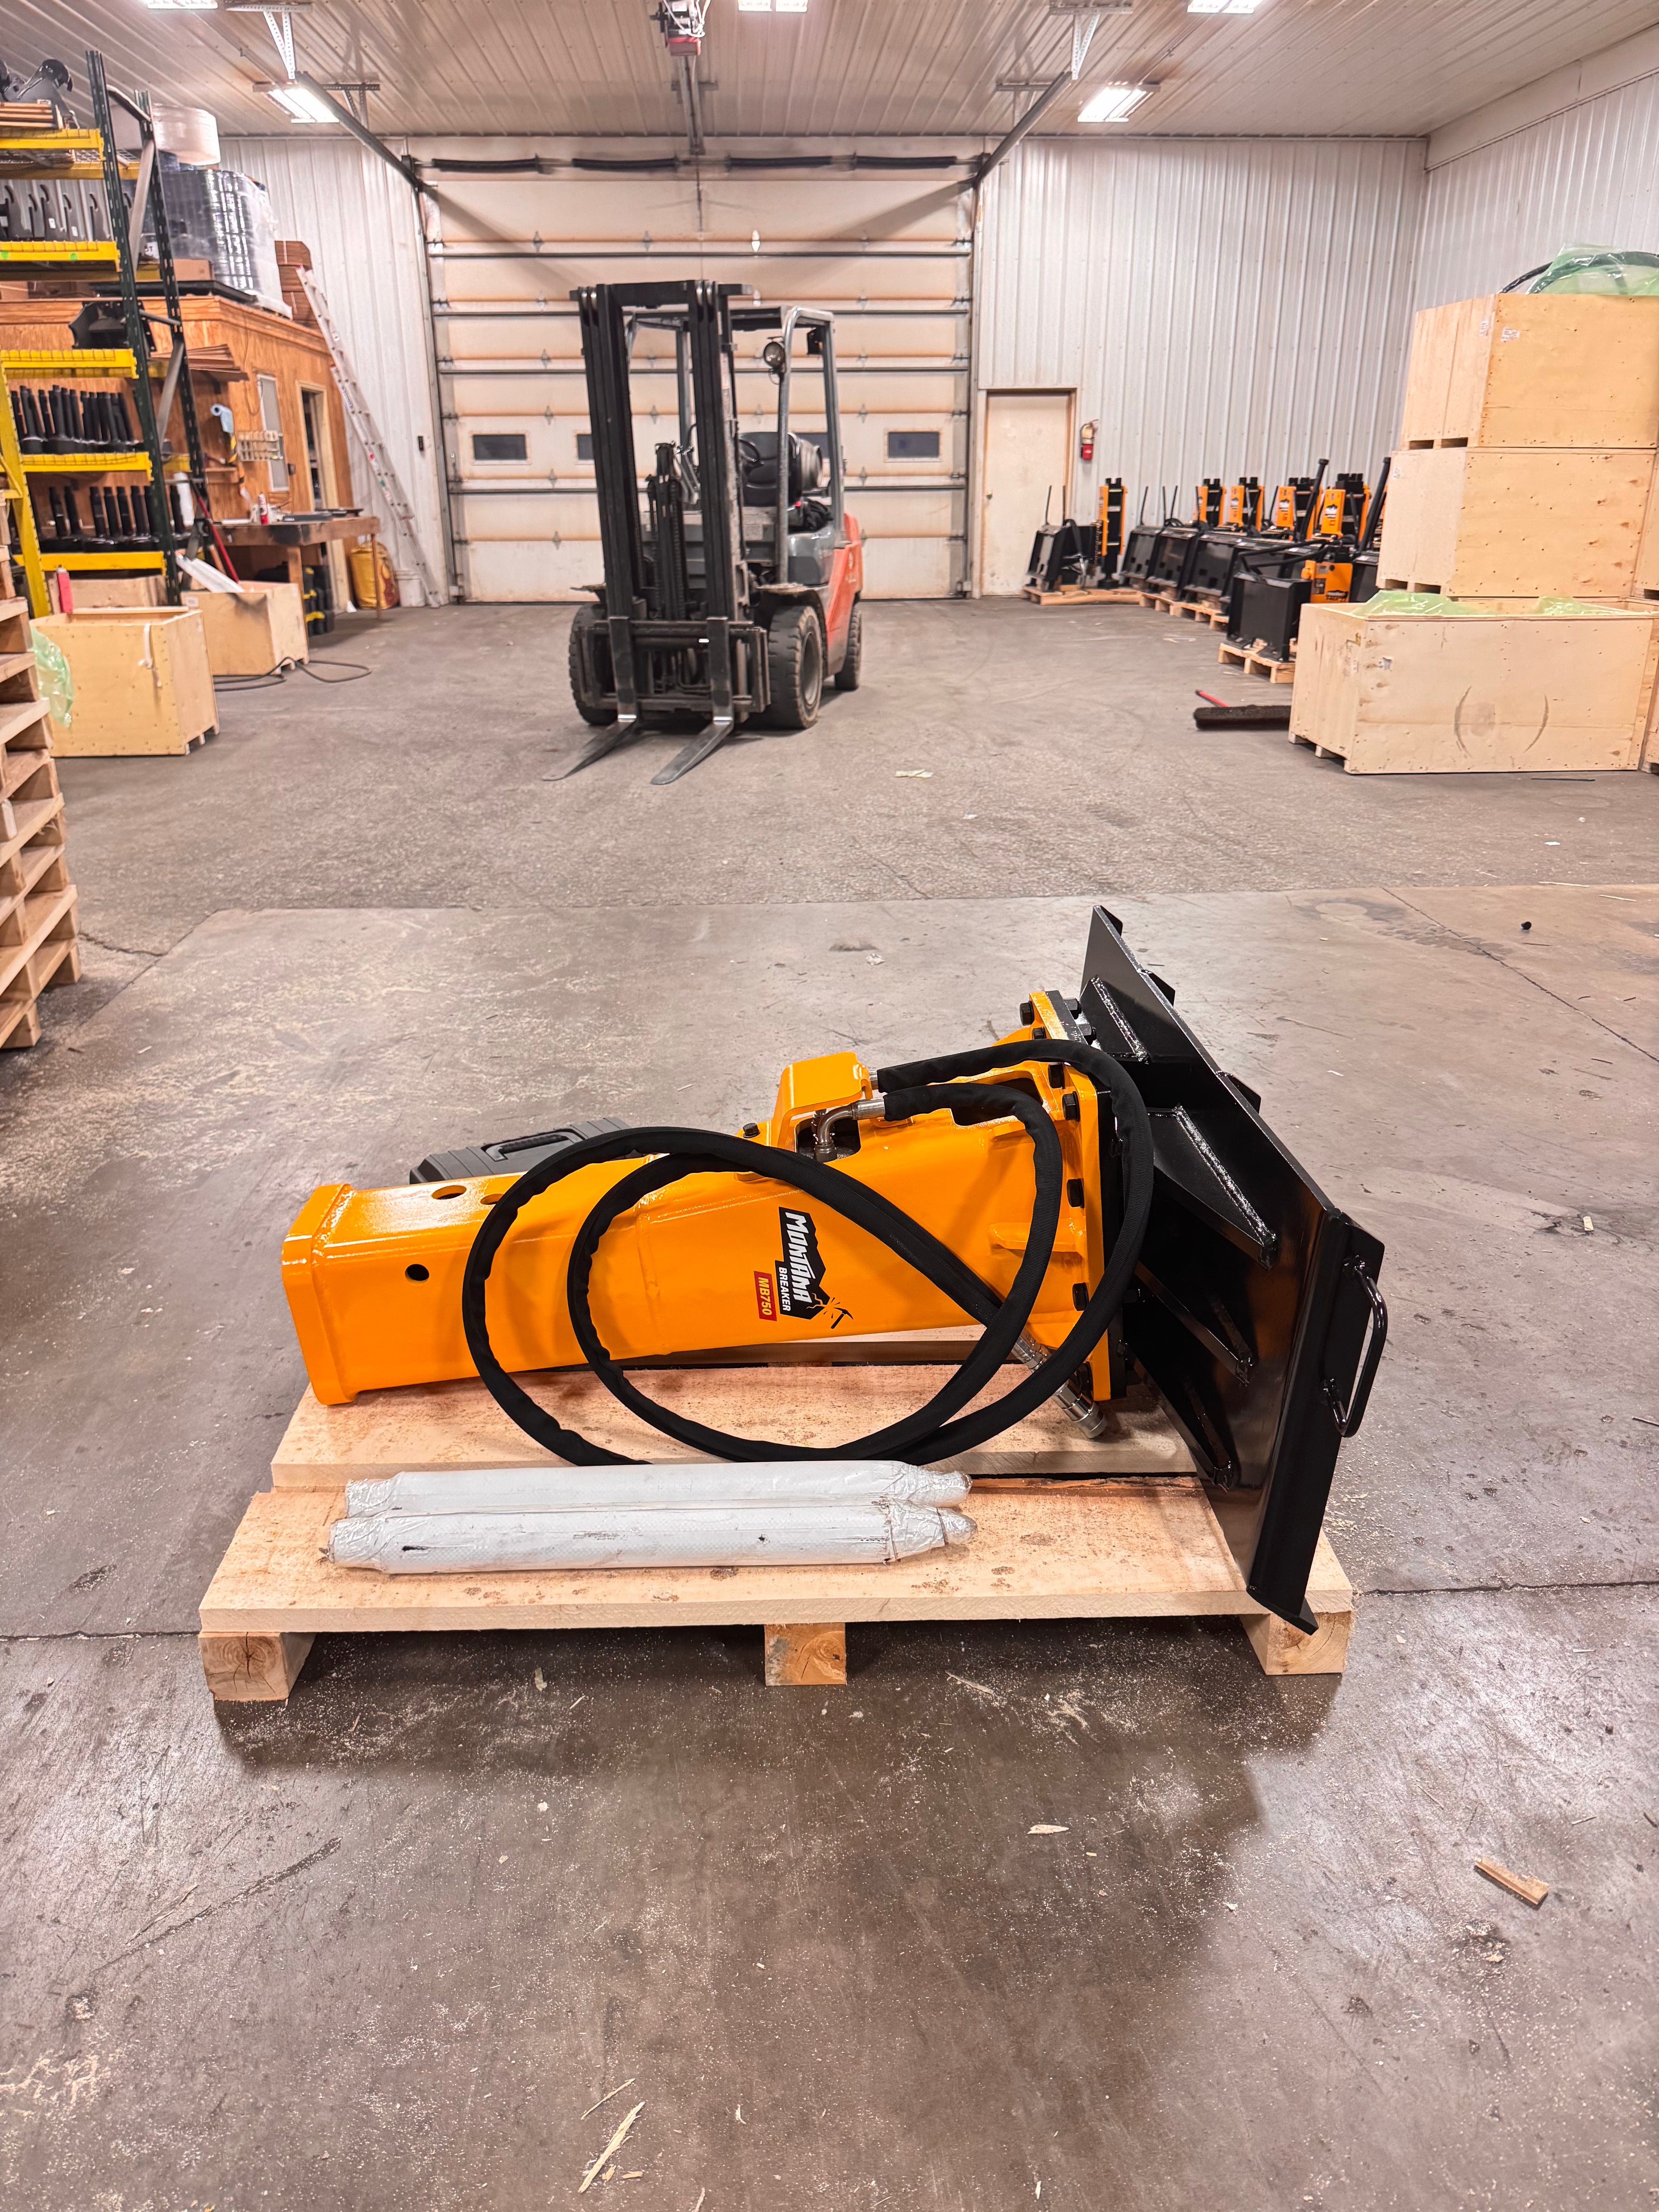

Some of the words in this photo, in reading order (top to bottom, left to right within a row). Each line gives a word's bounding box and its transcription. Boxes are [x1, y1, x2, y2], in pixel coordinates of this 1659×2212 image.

[785, 1212, 815, 1303] MONTANA
[758, 1277, 772, 1316] MB750
[779, 1267, 791, 1311] BREAKER
